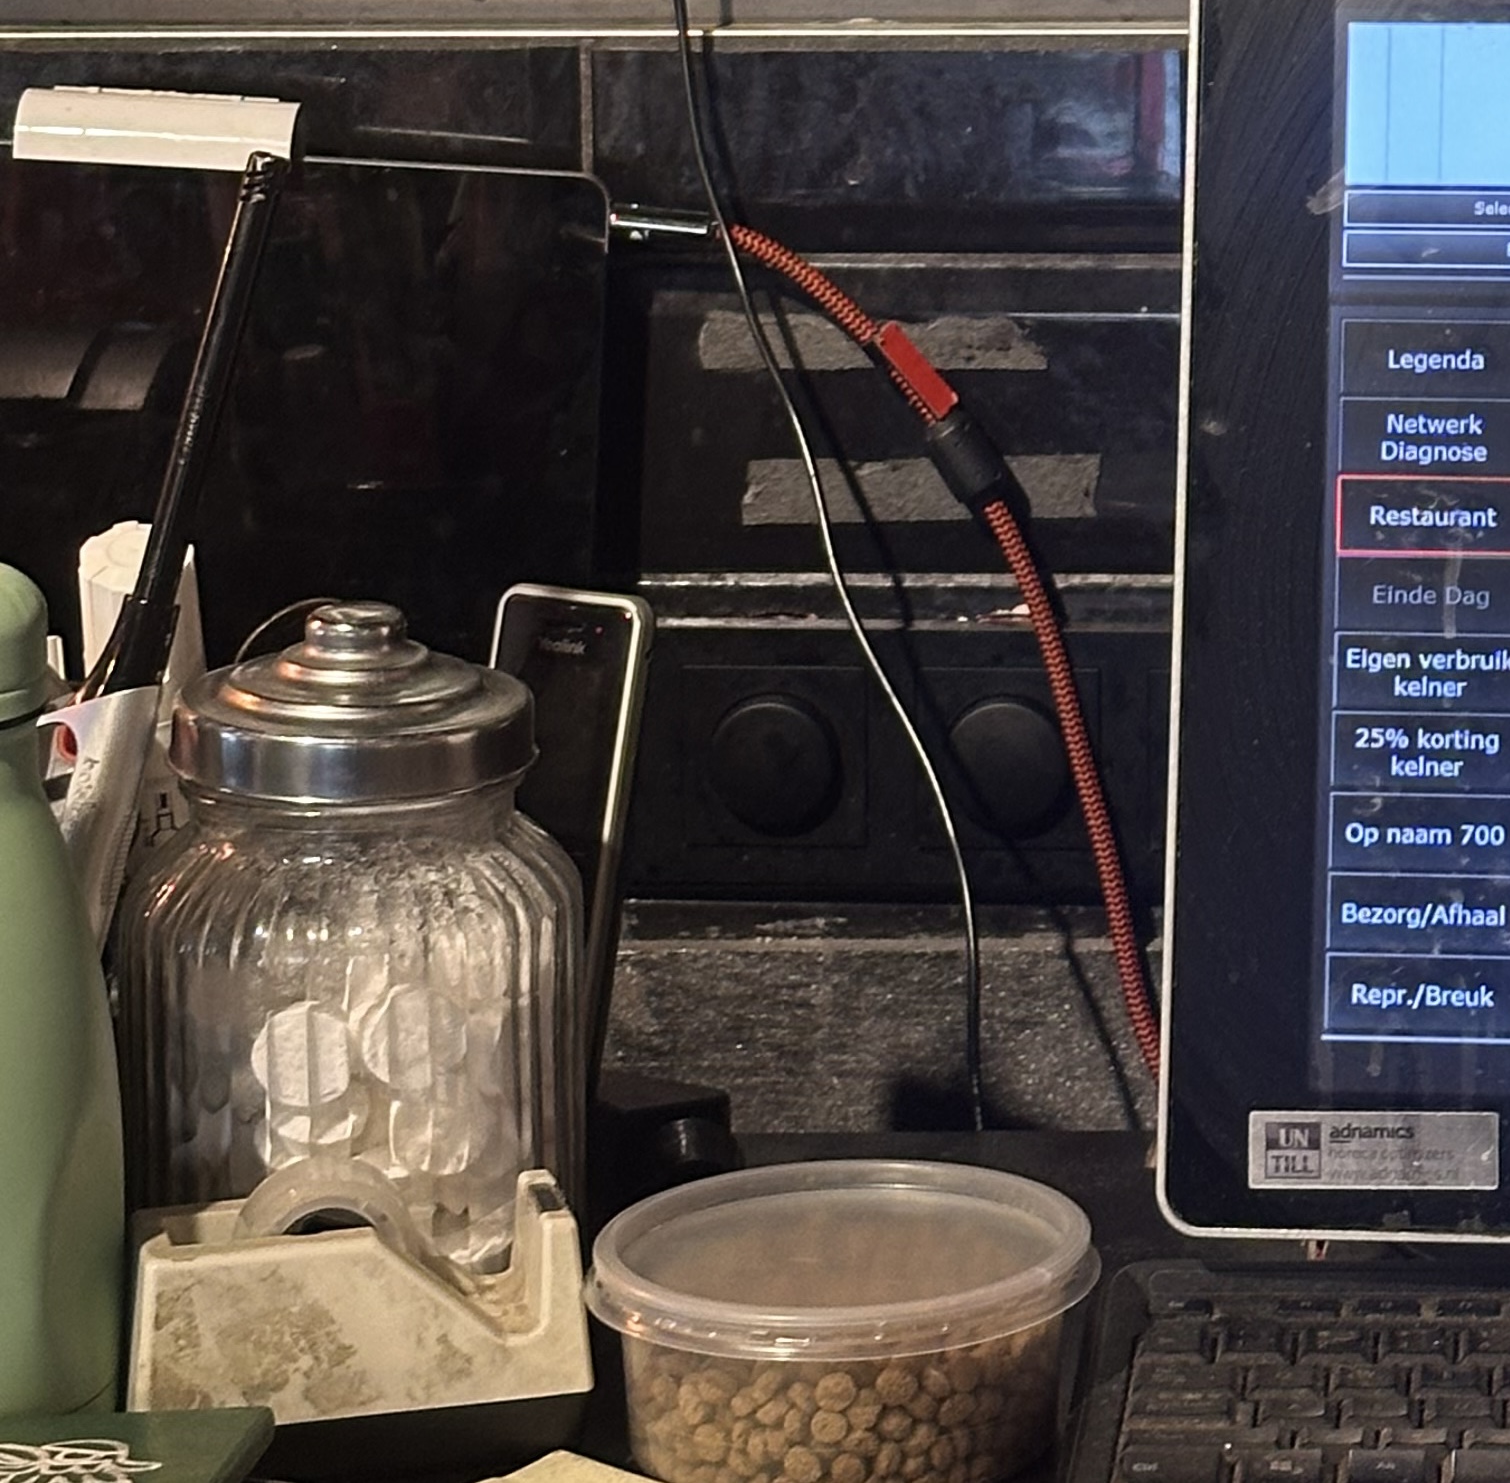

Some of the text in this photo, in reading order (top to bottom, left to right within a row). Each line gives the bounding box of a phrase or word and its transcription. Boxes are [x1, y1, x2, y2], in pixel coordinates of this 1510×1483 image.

[1388, 349, 1485, 373] Legenda
[1386, 414, 1483, 435] Netwerk
[1380, 441, 1488, 465] Diagnose
[1370, 505, 1498, 528] Restaurant
[1372, 585, 1490, 609] Einde Dag
[1346, 648, 1411, 673] Eigen
[1394, 675, 1467, 698] kelner
[1355, 728, 1500, 754] 25% korting
[1390, 755, 1463, 778] kelner
[1345, 823, 1505, 848] Op naam 700
[1341, 902, 1506, 929] Bezorg/Afhaal
[1351, 983, 1495, 1011] Repr./Breuk
[1278, 1127, 1310, 1148] UN
[1328, 1123, 1416, 1140] adnamics
[1270, 1154, 1315, 1175] TILL
